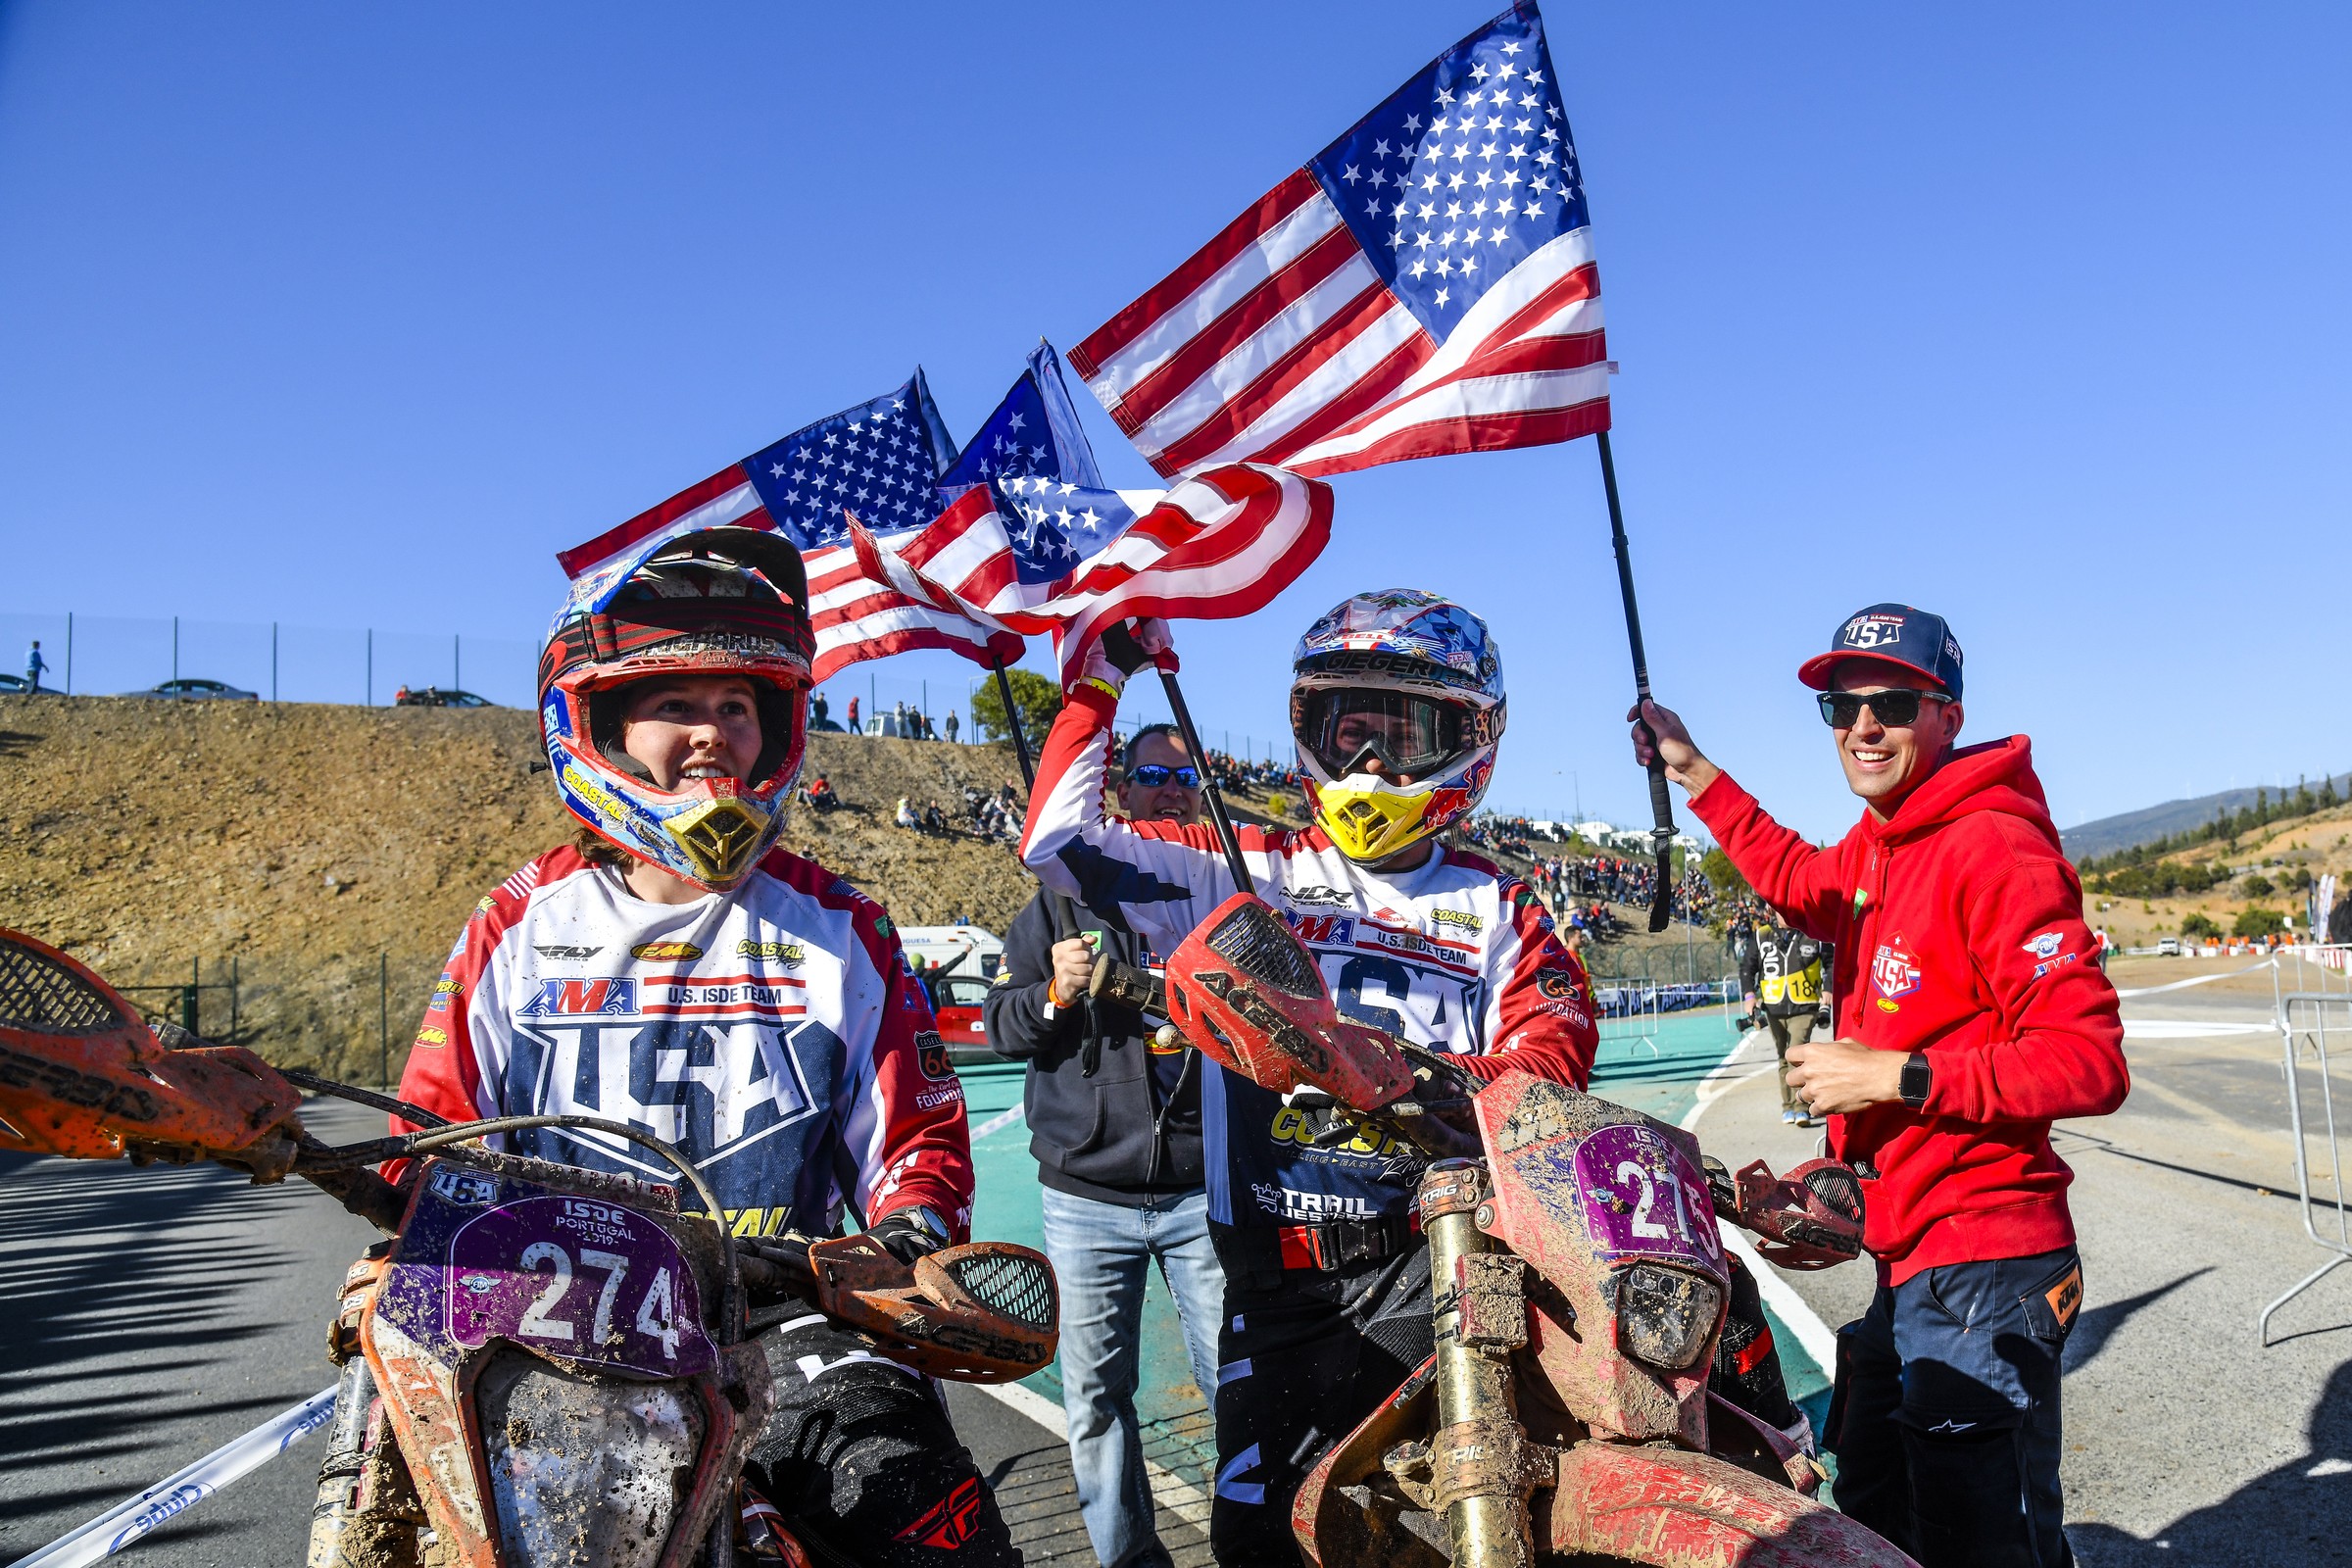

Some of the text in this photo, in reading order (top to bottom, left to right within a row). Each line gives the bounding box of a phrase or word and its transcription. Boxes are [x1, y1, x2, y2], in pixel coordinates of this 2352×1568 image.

[1342, 631, 1384, 640] BELL
[1845, 622, 1900, 647] USA
[1326, 653, 1430, 677] GIEGER
[564, 765, 628, 821] COASTAL
[1431, 908, 1484, 928] COASTAL
[538, 946, 605, 956] FLY
[640, 944, 702, 956] FMF
[736, 939, 804, 959] COASTAL
[1378, 931, 1401, 948] U.S.
[1434, 946, 1467, 965] TEAM
[1874, 957, 1911, 994] USA
[516, 978, 640, 1015] AMA
[668, 985, 782, 1004] U.S. ISDE TEAM
[920, 1034, 944, 1047] CASELL
[924, 1051, 956, 1076] 66
[537, 1023, 810, 1152] USA
[915, 1089, 965, 1109] FOUNDA
[1339, 1157, 1378, 1170] EAST
[564, 1200, 626, 1226] ISDE
[1279, 1187, 1377, 1215] TRAIL
[1617, 1160, 1719, 1261] 275
[556, 1216, 637, 1242] PORTUGAL
[518, 1241, 680, 1361] 274
[2057, 1278, 2081, 1316] KTM
